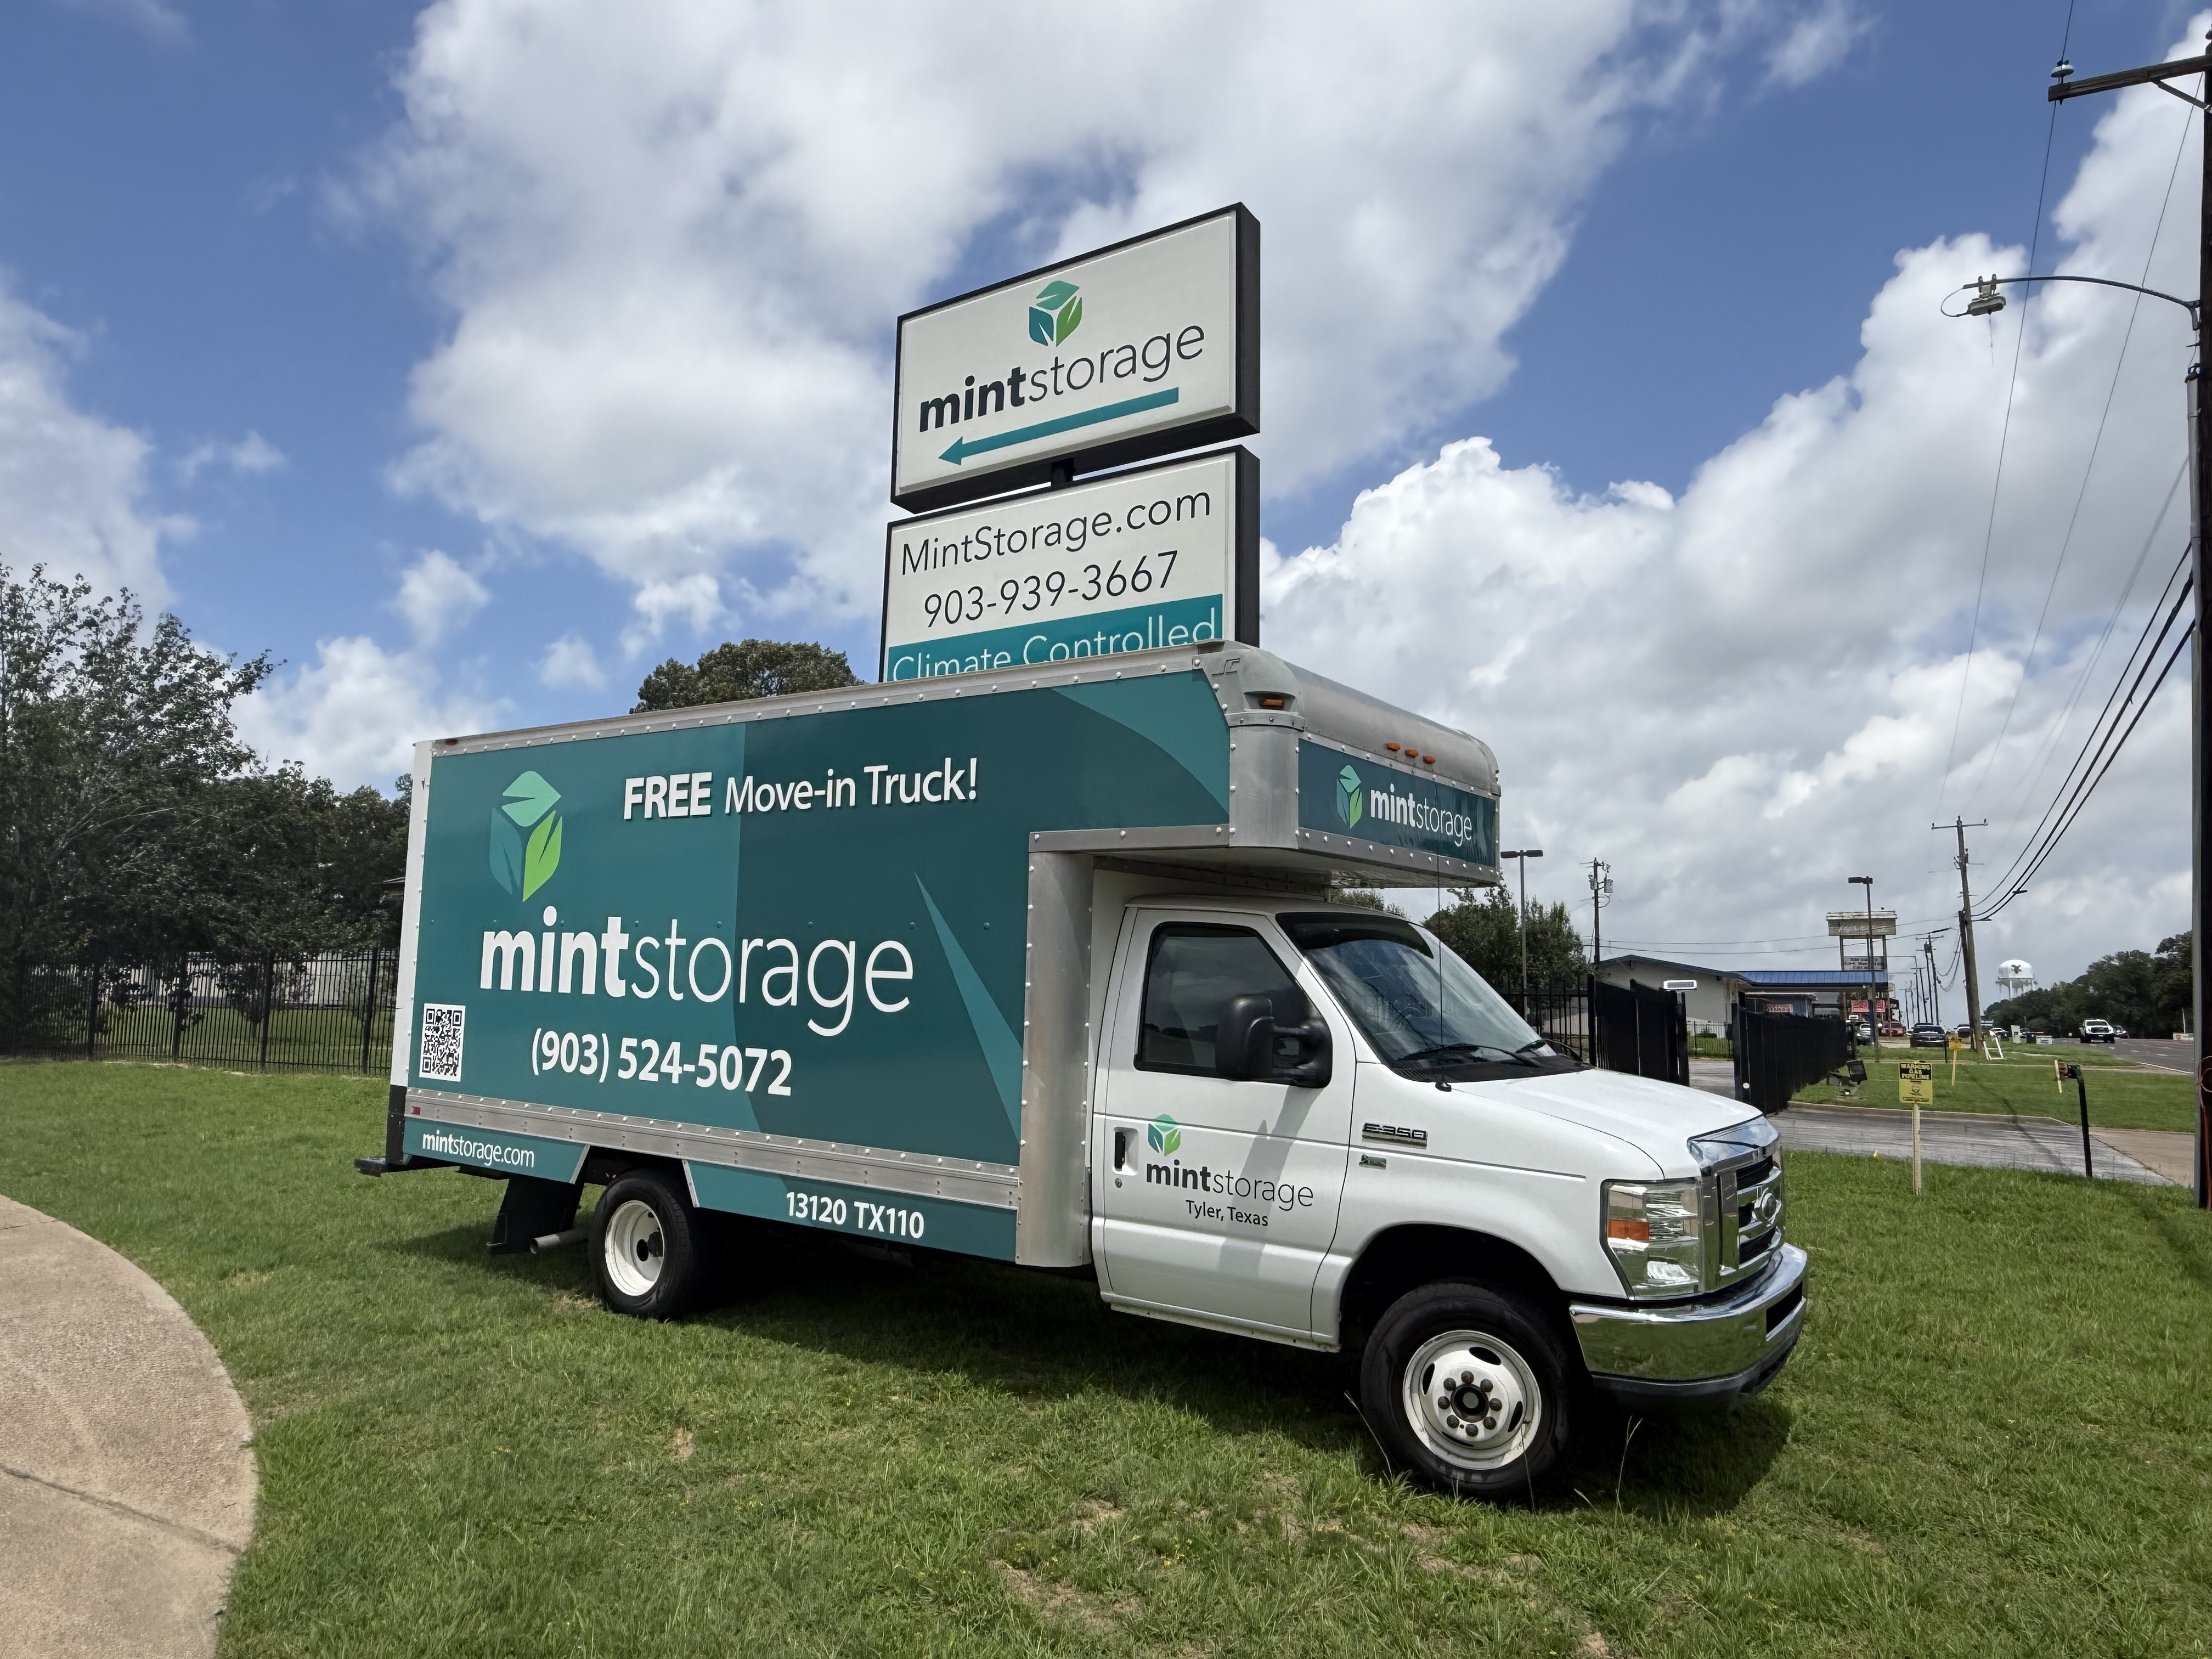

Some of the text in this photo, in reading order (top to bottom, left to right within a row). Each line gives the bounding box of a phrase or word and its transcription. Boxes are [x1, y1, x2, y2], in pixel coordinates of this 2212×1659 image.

[919, 325, 1205, 432] mintstorage
[902, 492, 1210, 575] MintStorage.com
[924, 551, 1178, 628] 903-939-3667
[893, 607, 1215, 681] Climate Controlled
[624, 758, 978, 820] FREE Move-in Truck!
[1370, 783, 1472, 847] mintstorage
[480, 906, 913, 1037] mintstorage
[532, 1028, 792, 1096] (903) 524-5072
[422, 1130, 534, 1167] mintstorage.com
[786, 1192, 924, 1239] 13120 TX110
[1146, 1159, 1314, 1211] mintstorage
[1186, 1199, 1269, 1227] Tyler, Texas
